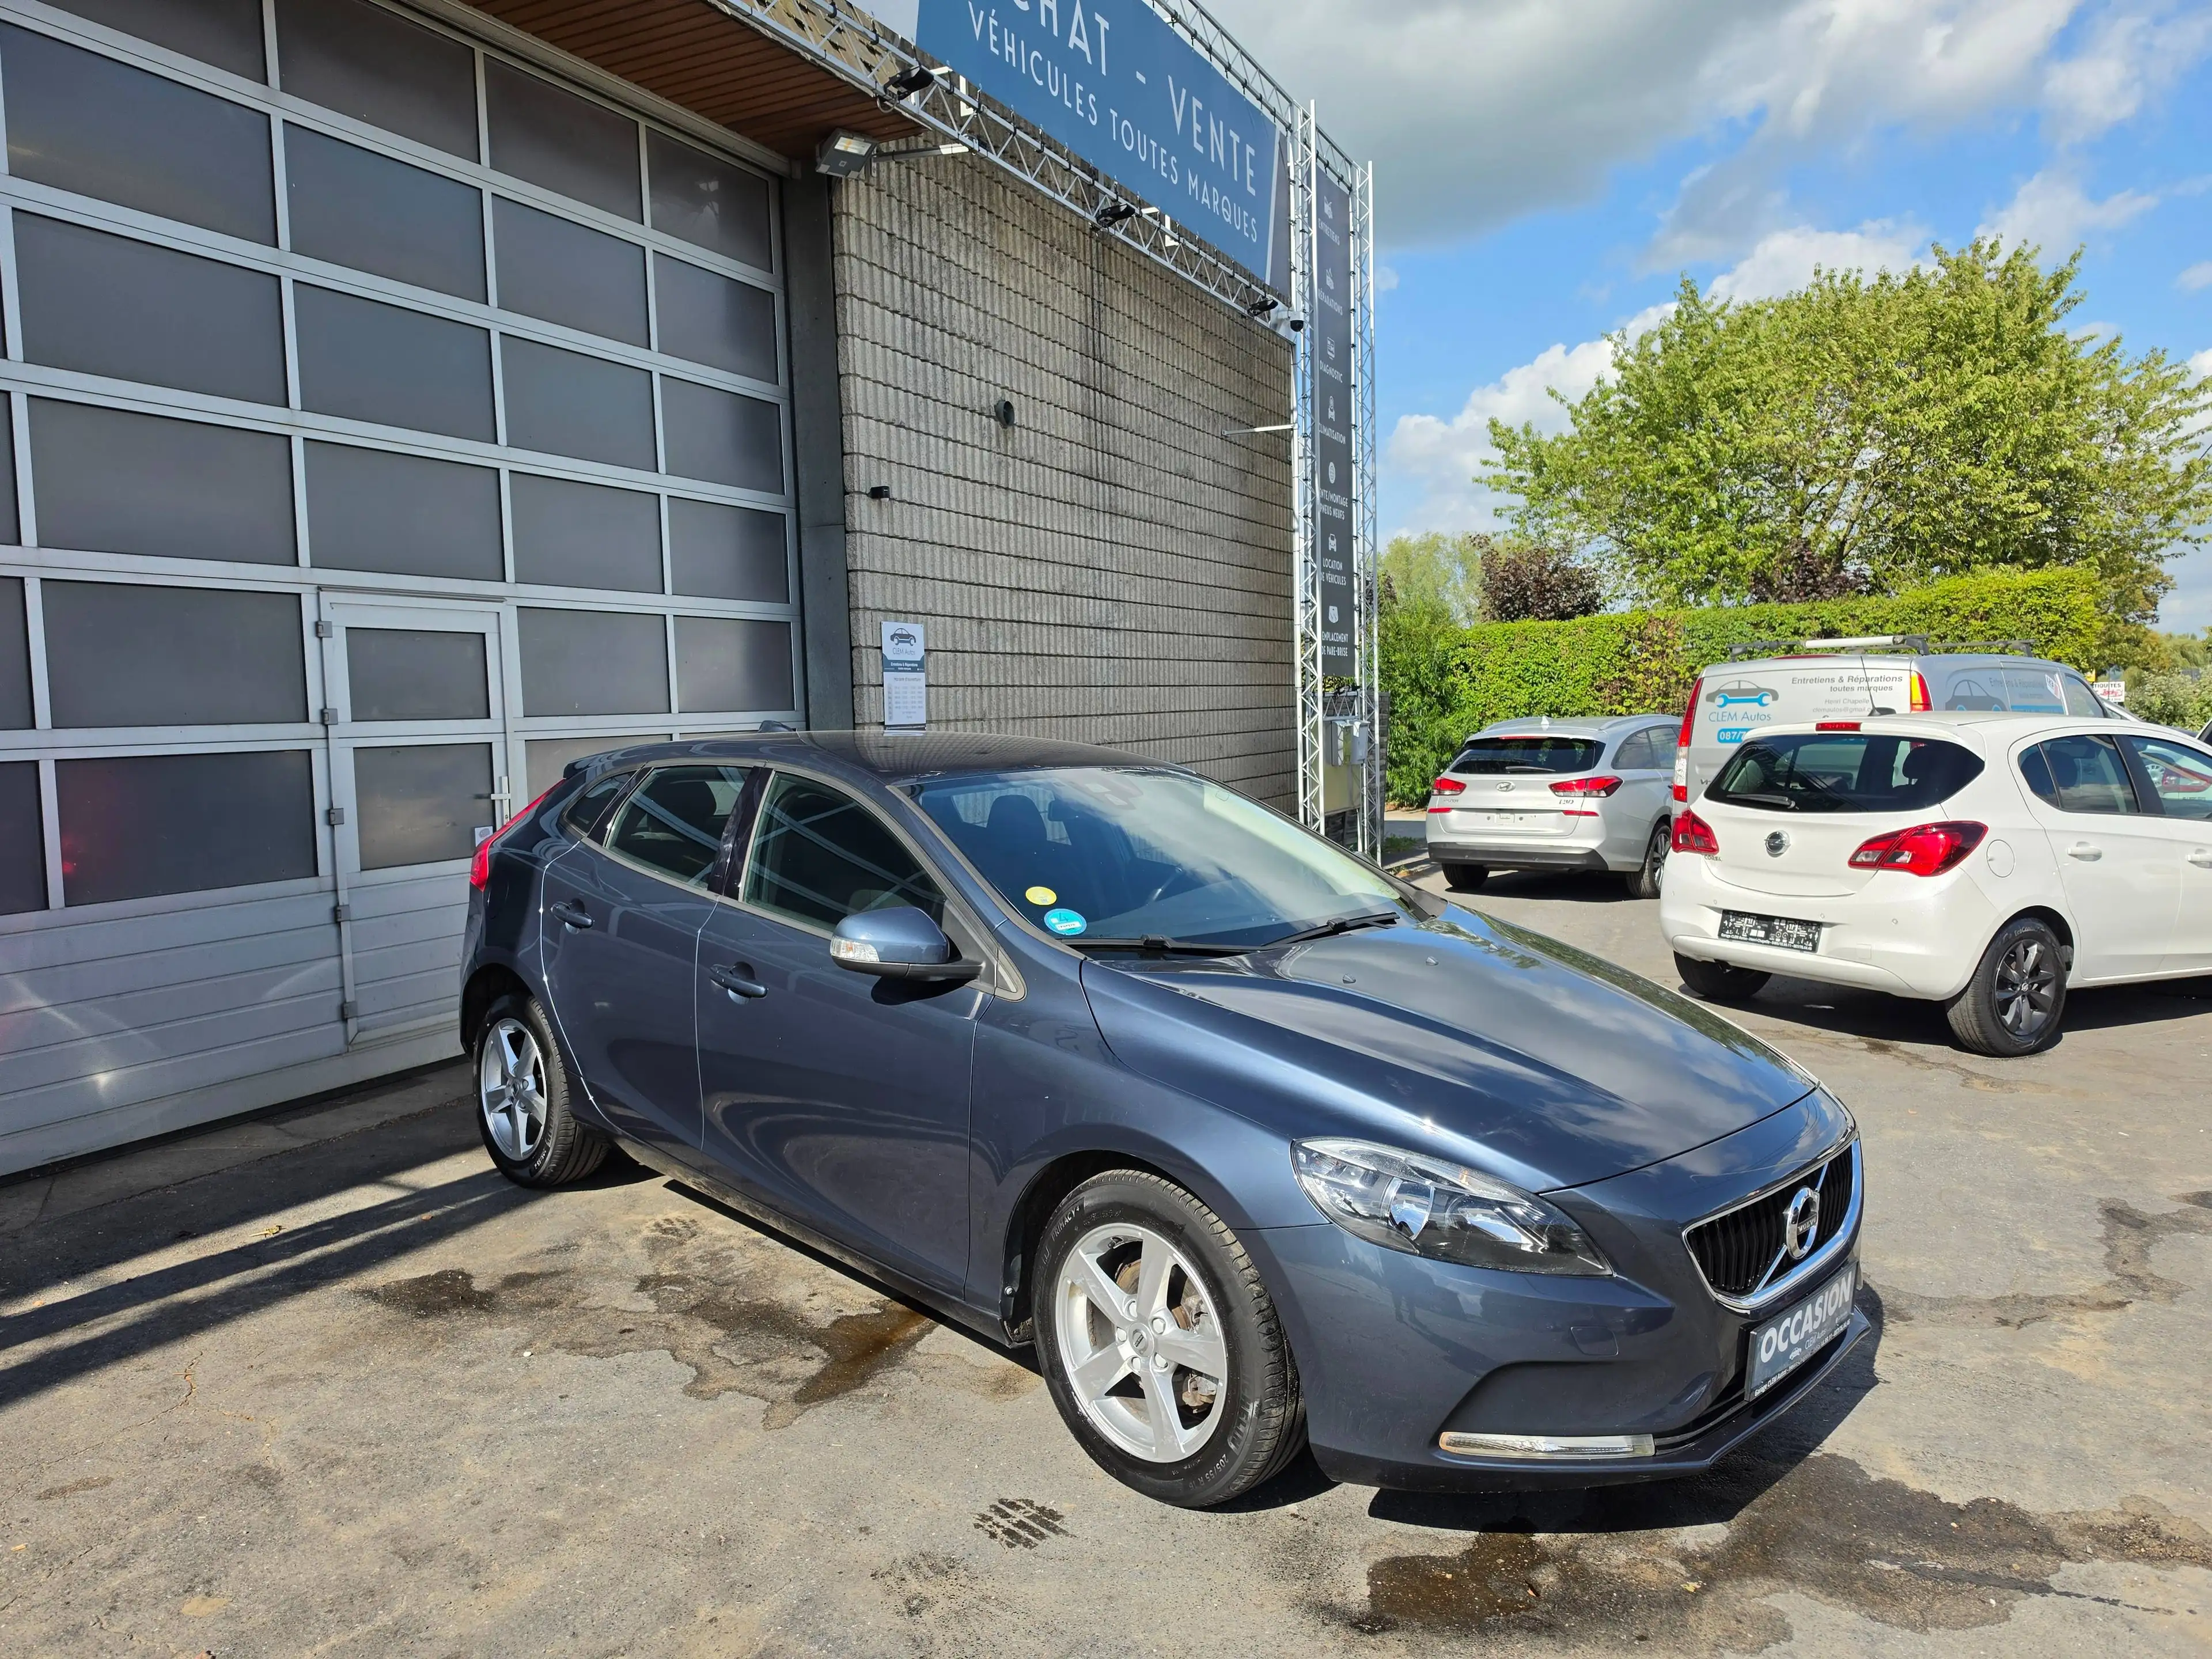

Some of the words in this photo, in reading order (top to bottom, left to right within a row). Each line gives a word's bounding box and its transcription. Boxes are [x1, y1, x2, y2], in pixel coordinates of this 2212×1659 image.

[1013, 0, 1109, 76] HAT
[1168, 75, 1256, 196] VENTE
[968, 1, 1098, 126] VÉHICULES
[1109, 108, 1178, 185] TOUTES
[1188, 168, 1257, 243] MARQUES
[1318, 218, 1340, 245] ENTRETIENS
[1319, 359, 1343, 383] DIAGNOSTIC
[1332, 507, 1345, 520] NEUFS
[1323, 558, 1343, 571] LOCATION
[1325, 570, 1347, 585] VÉHICULES
[1321, 631, 1349, 643] EMPLACEMENT
[1847, 675, 1903, 685] Réparations
[1857, 684, 1893, 693] marques
[1709, 711, 1737, 722] CLEM
[1741, 711, 1772, 722] Autos
[1719, 732, 1745, 740] 087/7
[1051, 1208, 1076, 1242] PRIMACY
[1760, 1271, 1853, 1363] OCCASION
[1205, 1453, 1229, 1482] 205/55
